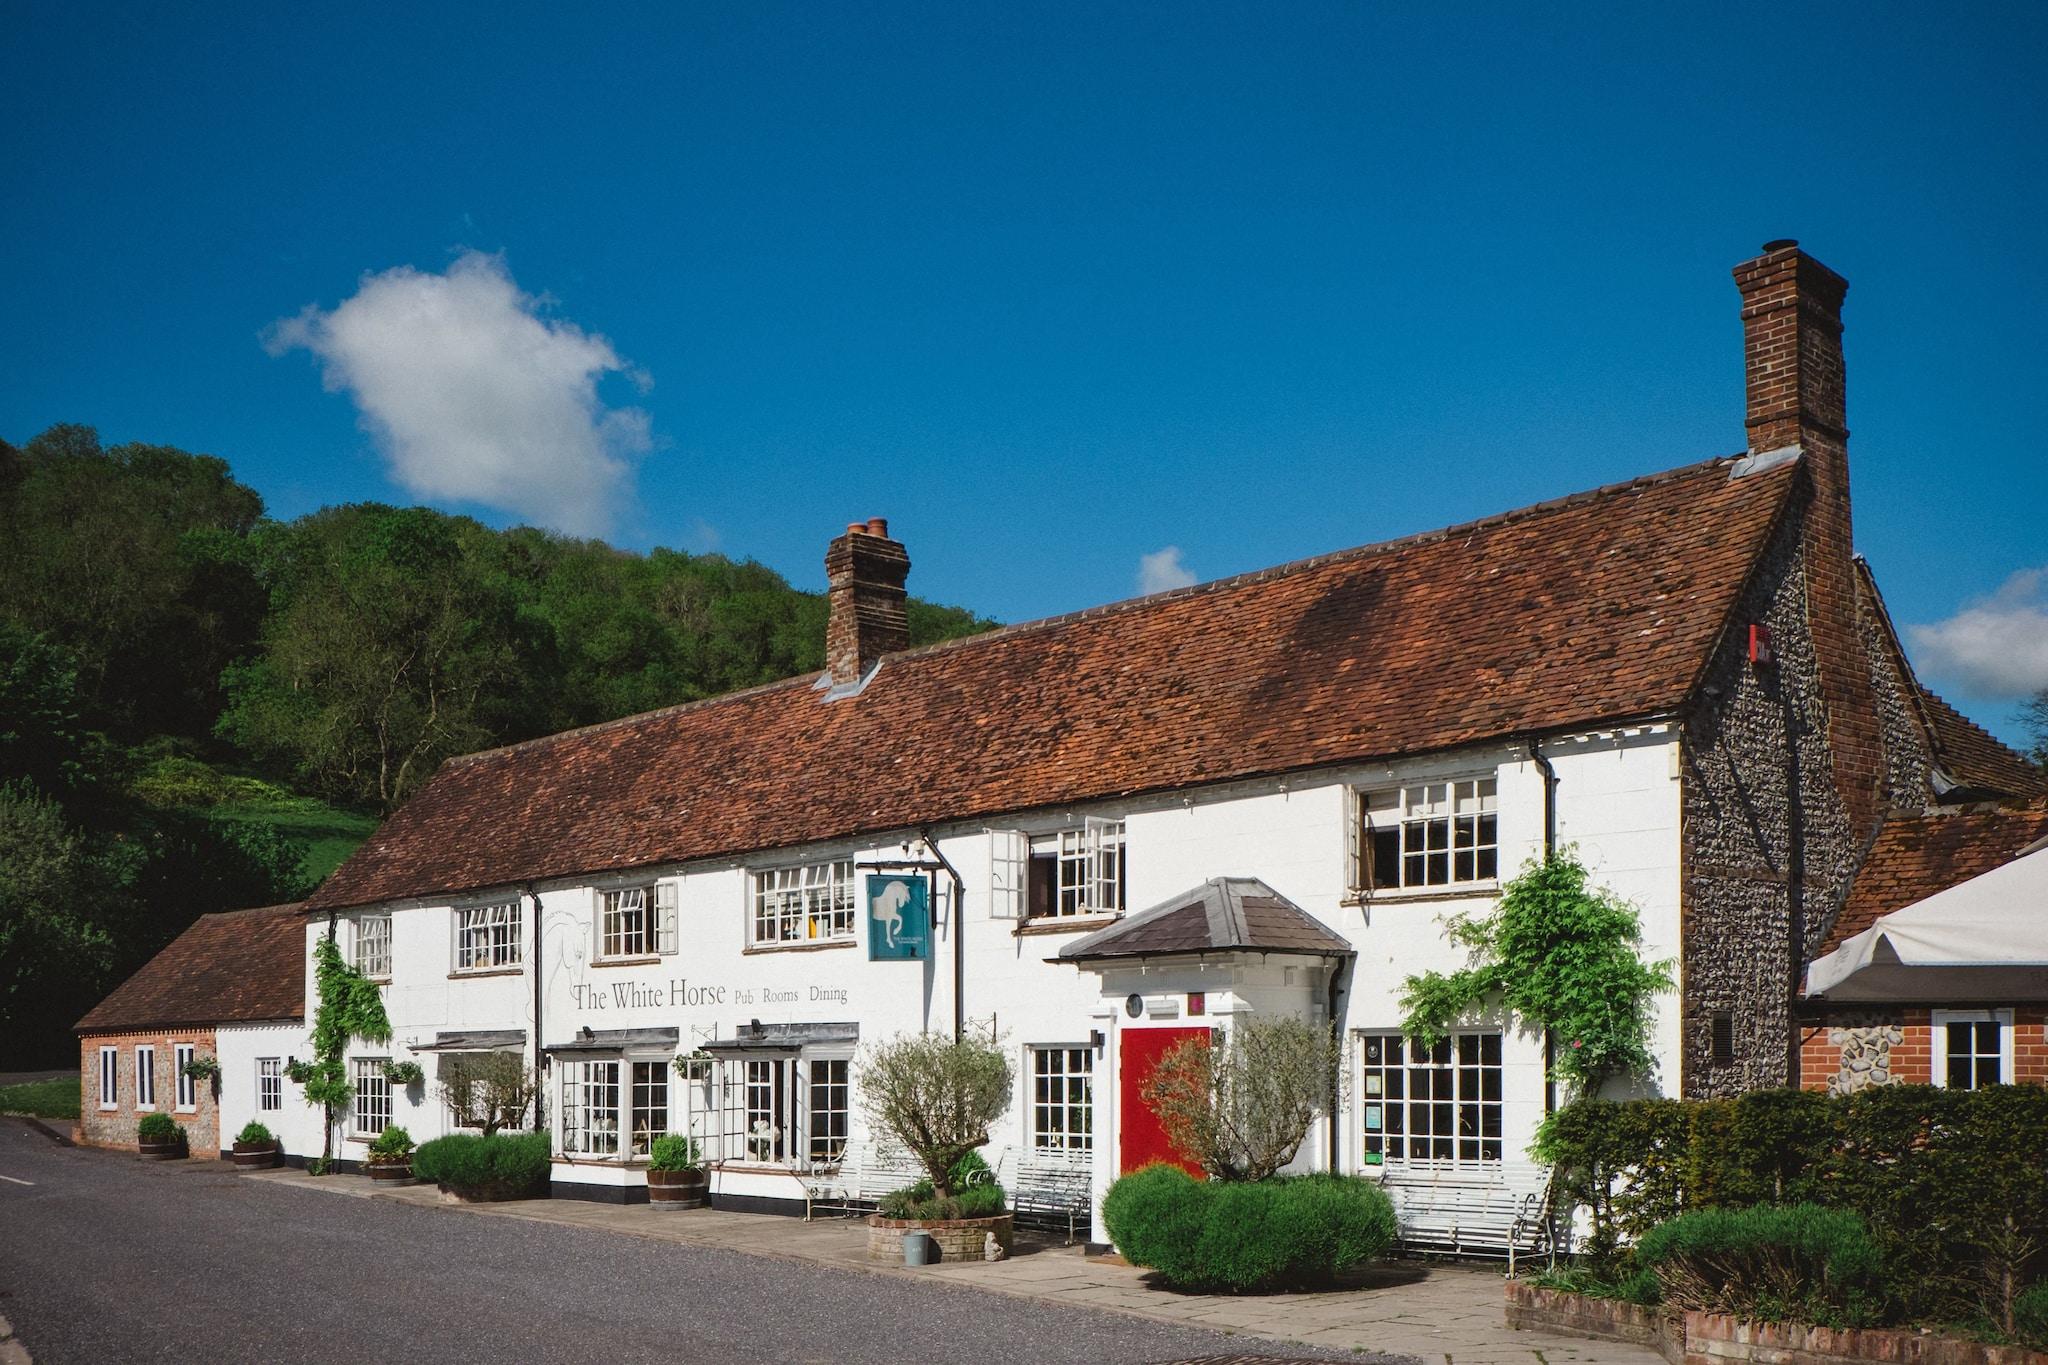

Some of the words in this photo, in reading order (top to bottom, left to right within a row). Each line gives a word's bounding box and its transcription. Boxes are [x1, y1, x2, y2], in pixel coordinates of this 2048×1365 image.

[573, 983, 607, 1010] The
[611, 981, 663, 1009] White
[669, 978, 726, 1006] Horse
[734, 989, 754, 1005] Pub
[763, 987, 799, 1003] Rooms
[809, 985, 848, 1005] Dining
